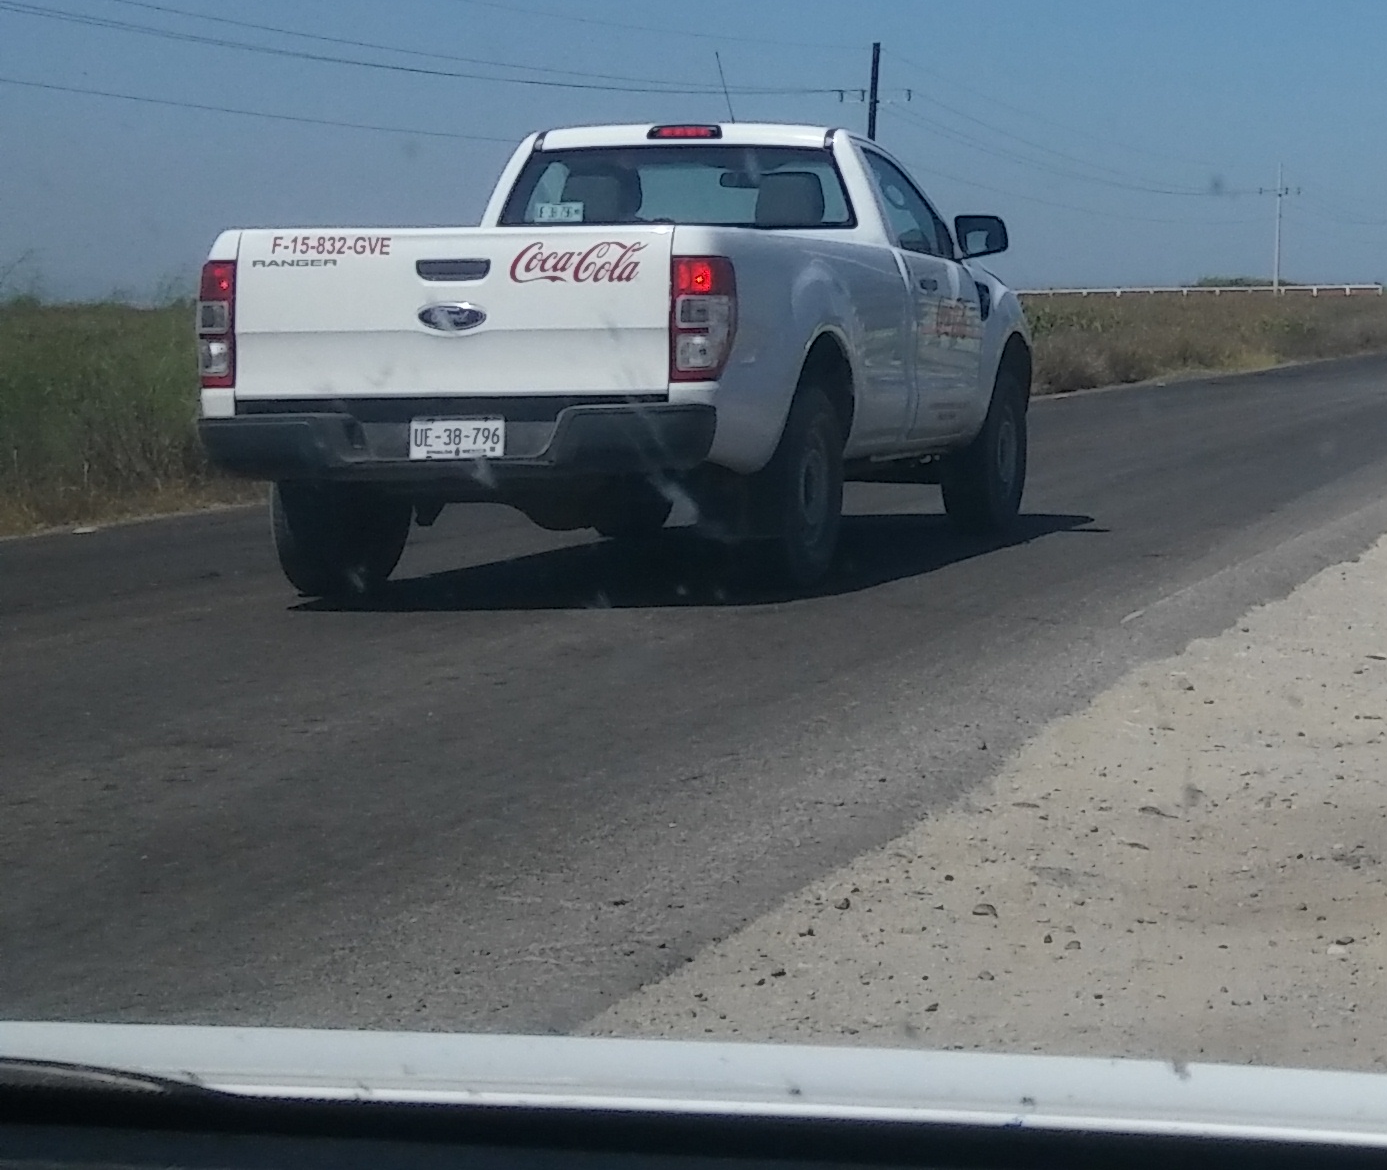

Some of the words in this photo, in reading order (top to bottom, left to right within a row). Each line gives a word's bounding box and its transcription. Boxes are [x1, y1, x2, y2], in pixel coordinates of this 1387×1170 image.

[272, 236, 392, 255] F-15-832-GVE
[252, 259, 337, 267] RANGER
[510, 241, 648, 283] Coca-Cola
[414, 428, 500, 447] UE-38-796
